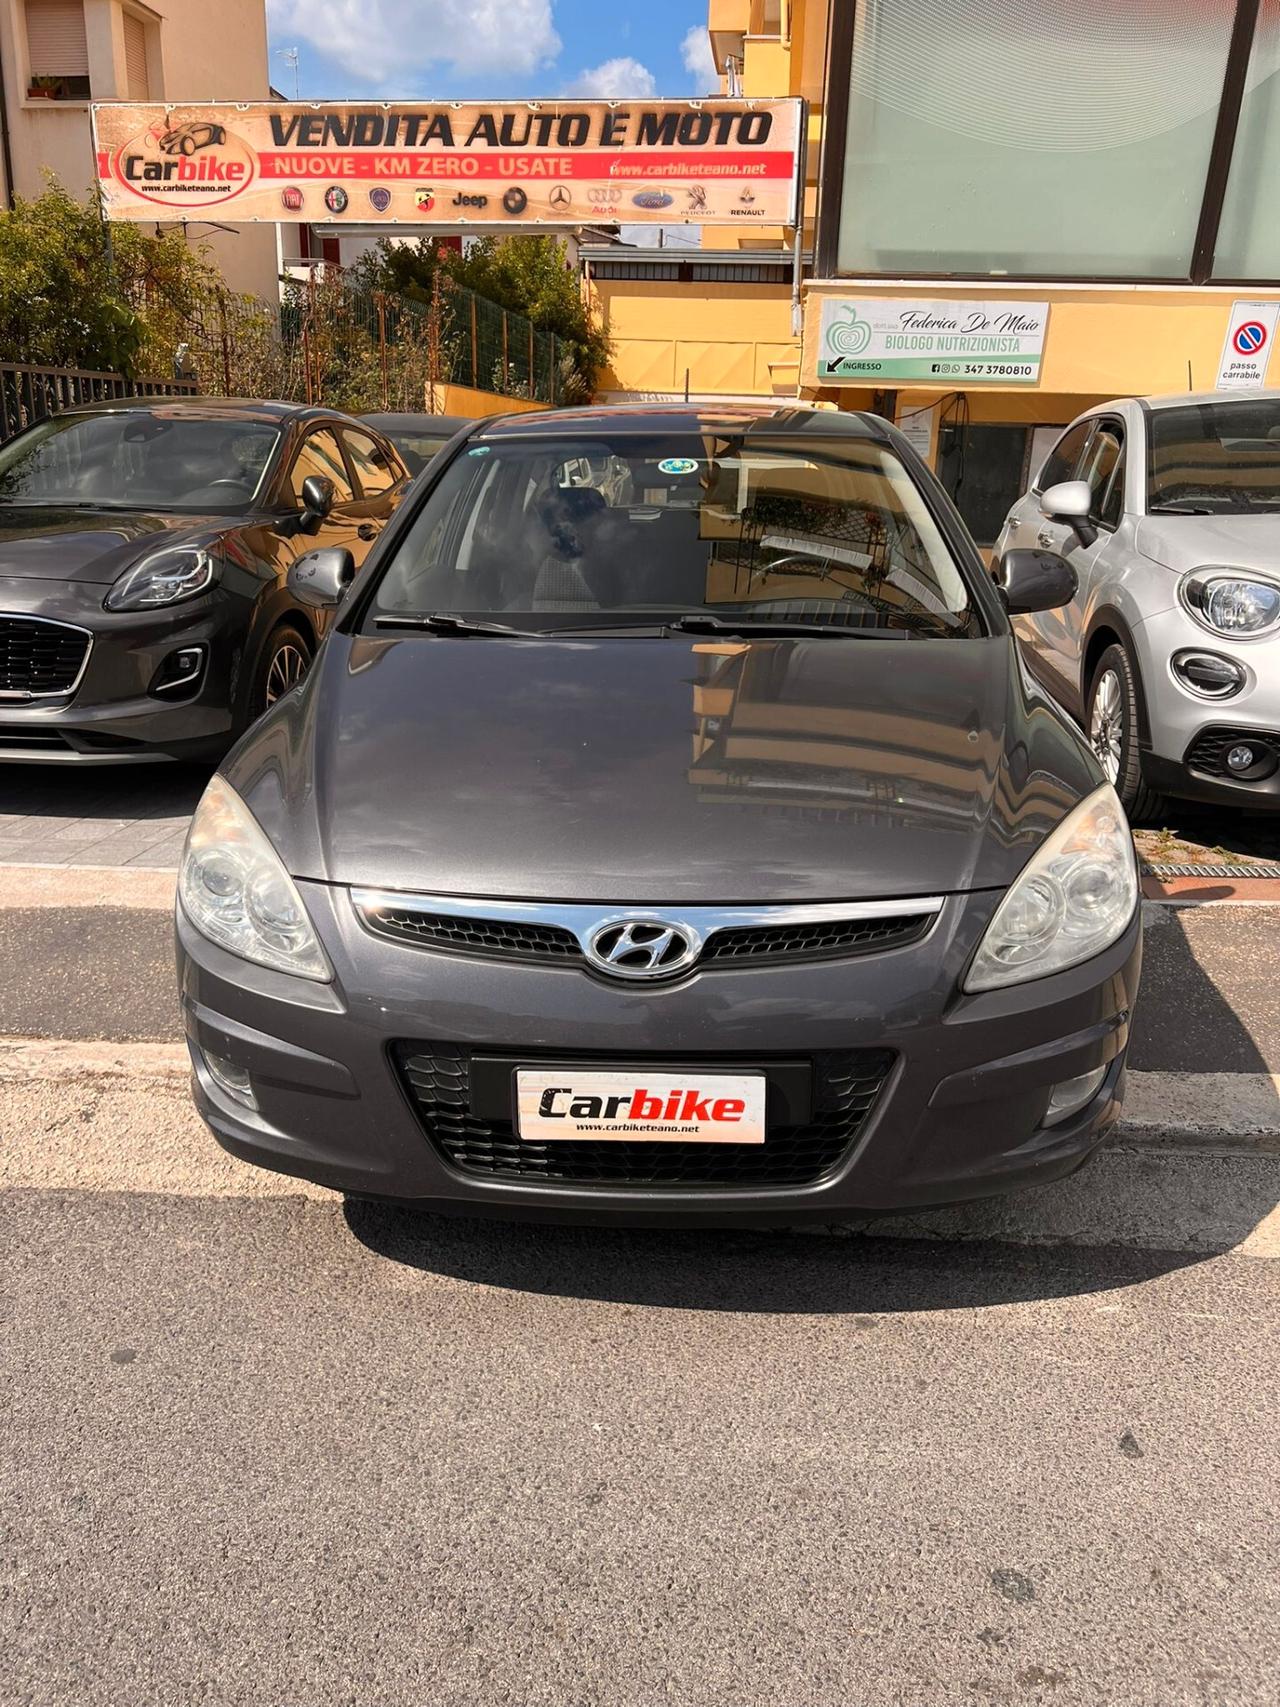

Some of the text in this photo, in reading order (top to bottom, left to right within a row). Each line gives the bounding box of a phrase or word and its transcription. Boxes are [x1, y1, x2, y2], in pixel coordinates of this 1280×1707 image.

[269, 112, 773, 147] VENDITA AUTO E MOTO
[125, 155, 245, 181] Carbike
[274, 157, 356, 175] NUOVE
[375, 157, 411, 175] KM
[417, 157, 479, 175] ZERO
[499, 157, 573, 176] USATE
[610, 162, 767, 176] www.carbiketeano.net
[141, 184, 231, 193] www.carbiketeano.net
[452, 192, 488, 208] Jeep
[900, 310, 958, 331] Federica
[960, 312, 991, 333] De
[994, 312, 1039, 335] Maio
[885, 335, 1020, 352] BIOLOGO NUTRIZIONISTA
[843, 362, 882, 371] INGRESSO
[964, 365, 1032, 375] 347 3780810
[1230, 362, 1257, 371] passo
[1222, 370, 1261, 380] carrabile
[538, 1087, 746, 1123] Carbike
[576, 1122, 700, 1134] www.carbiketeano.net
